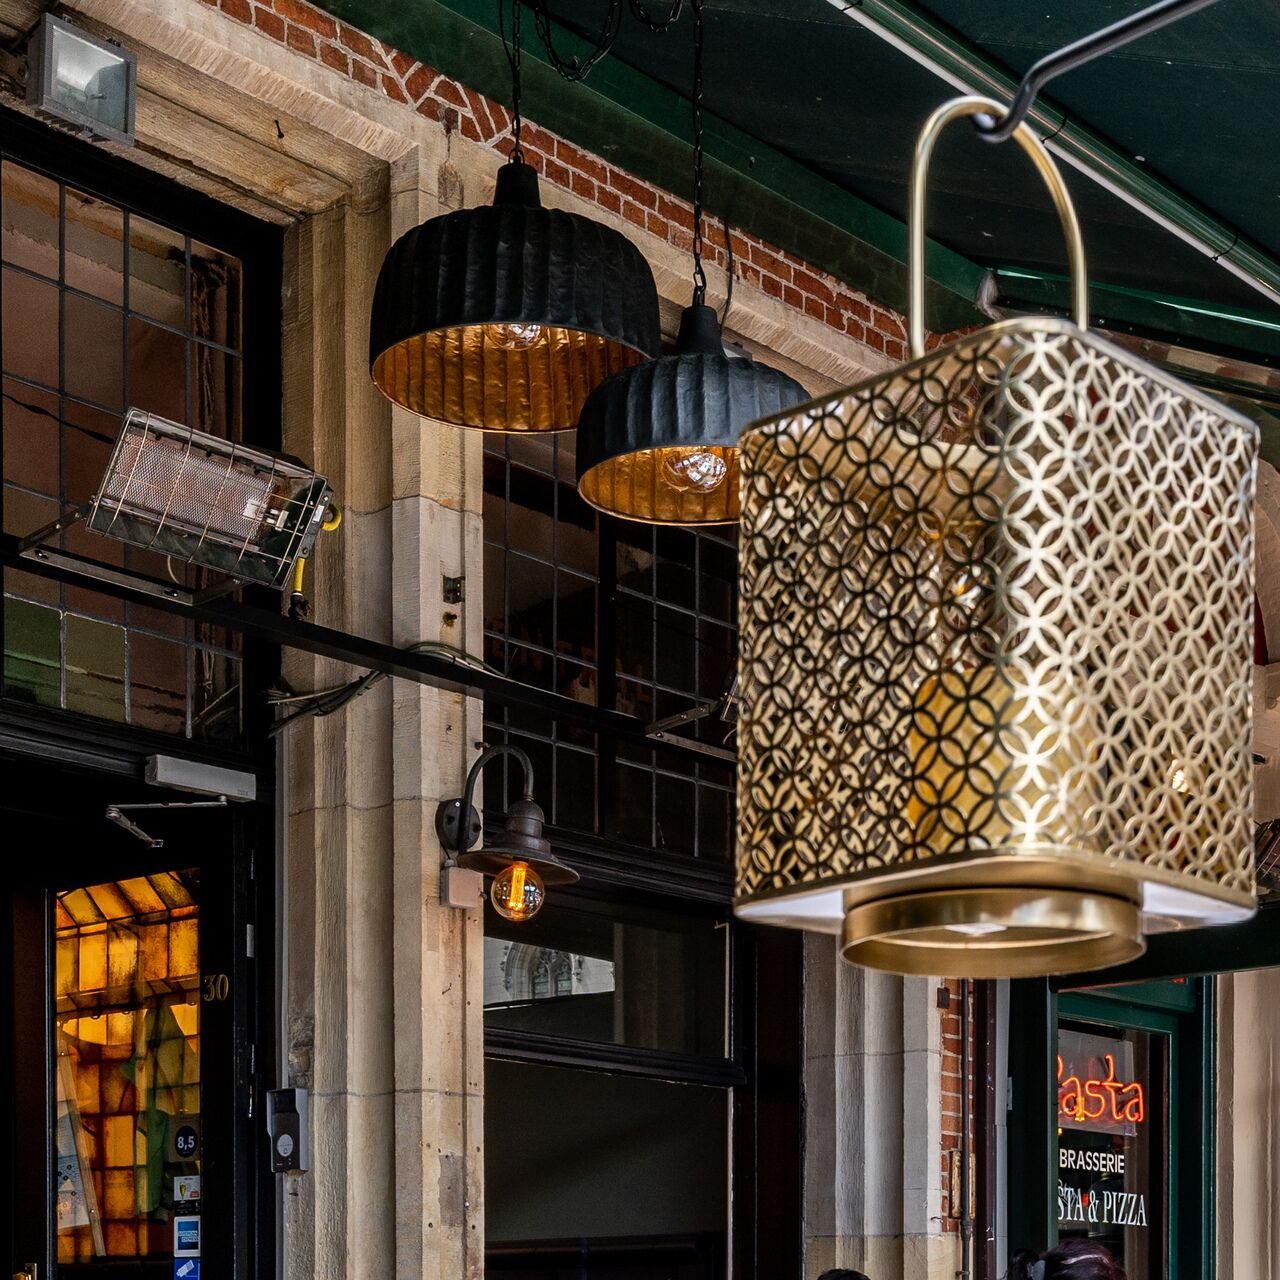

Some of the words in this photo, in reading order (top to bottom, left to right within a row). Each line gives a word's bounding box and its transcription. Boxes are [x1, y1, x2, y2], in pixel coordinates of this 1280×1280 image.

[177, 1136, 195, 1149] 8,5
[1059, 1149, 1125, 1174] BRASSERIE
[1088, 1190, 1099, 1223] &
[1103, 1191, 1148, 1227] PIZZA
